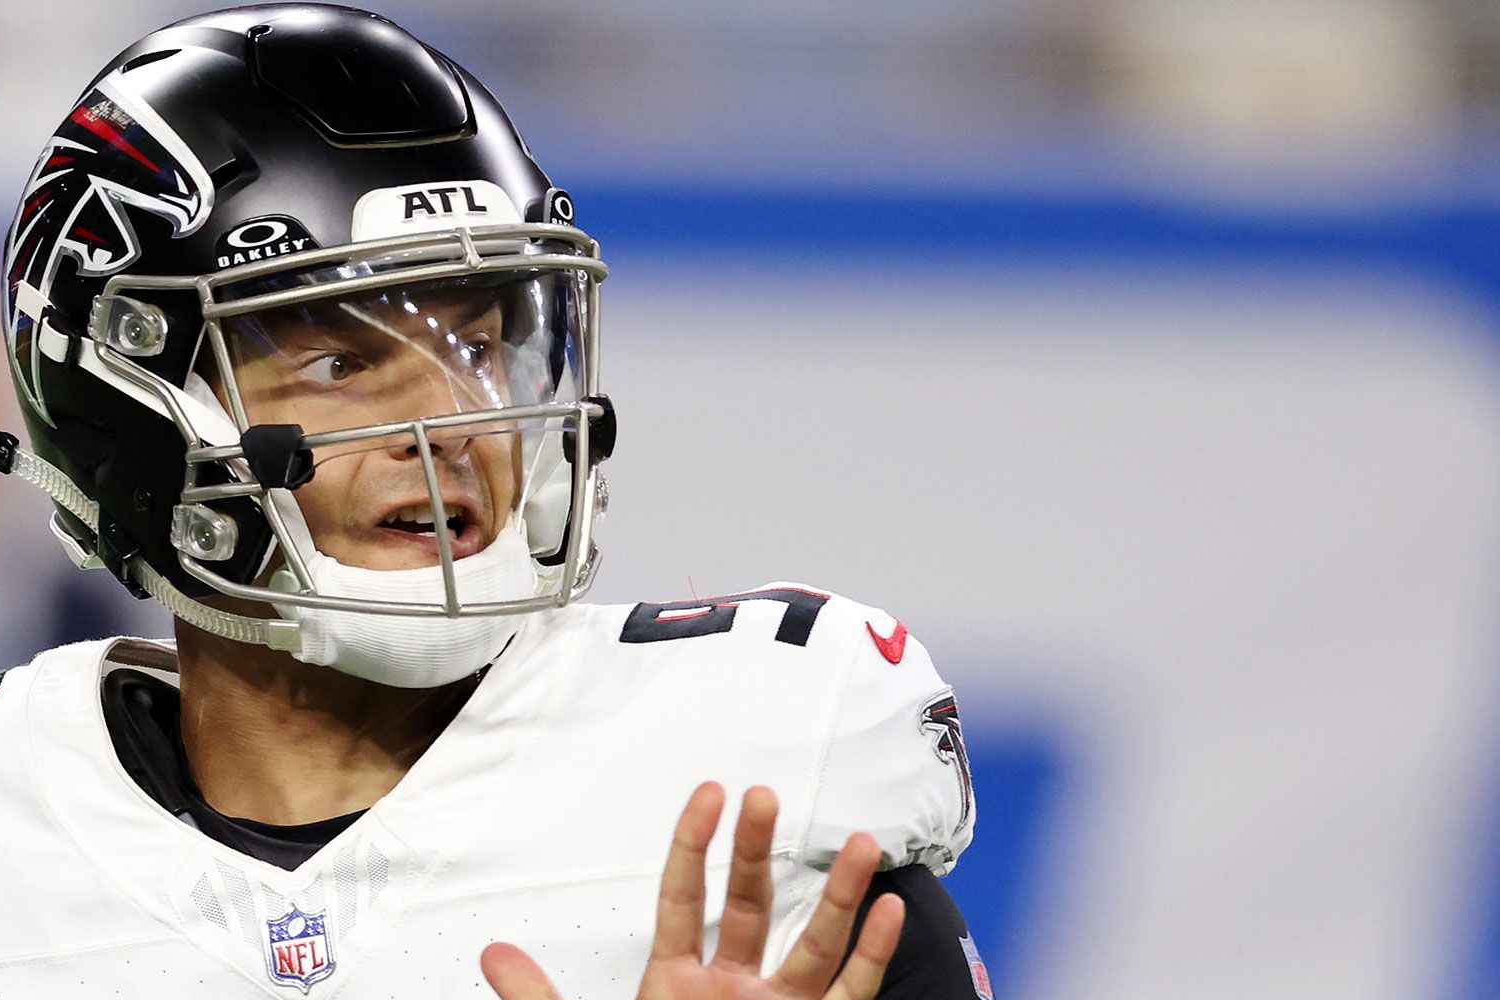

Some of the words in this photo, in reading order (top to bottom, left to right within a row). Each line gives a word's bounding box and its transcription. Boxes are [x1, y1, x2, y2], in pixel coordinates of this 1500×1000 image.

[401, 186, 487, 219] ATL
[217, 238, 306, 268] OAKLEY
[275, 940, 325, 976] NFL
